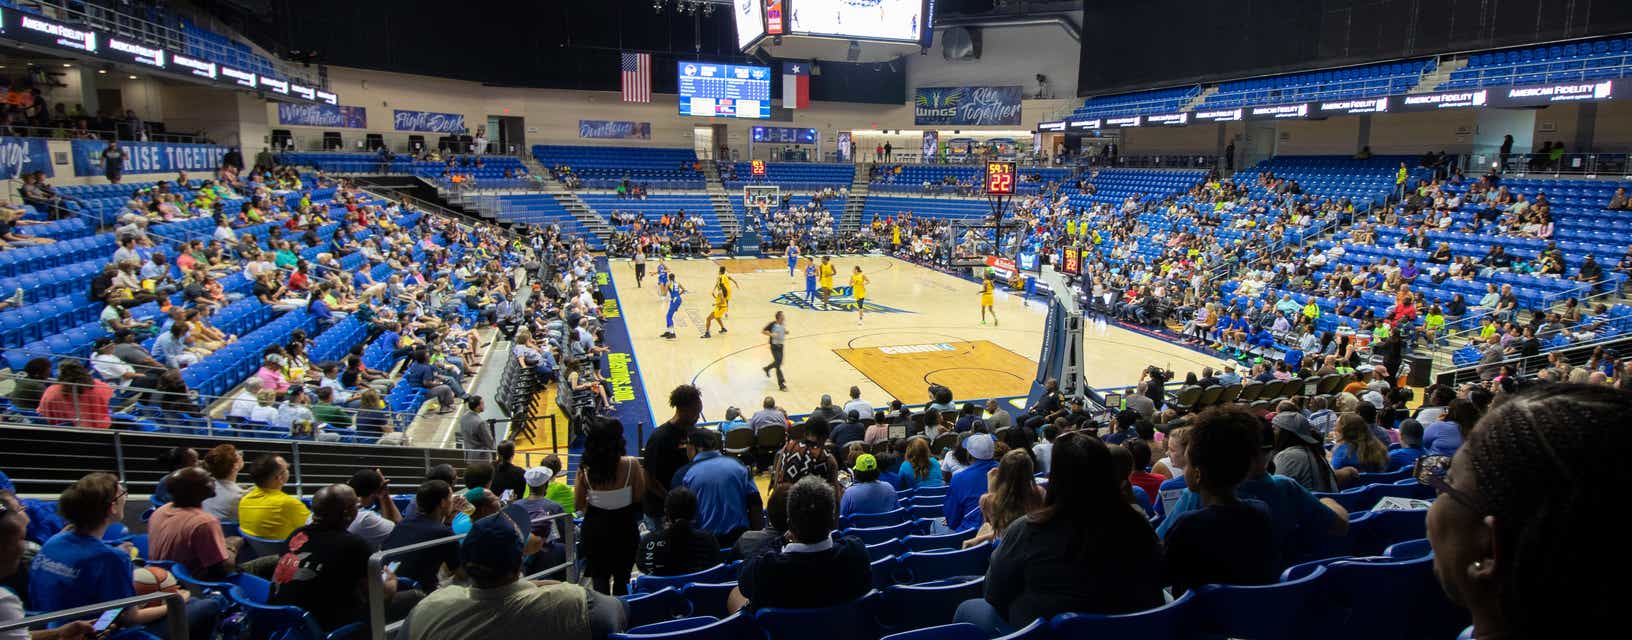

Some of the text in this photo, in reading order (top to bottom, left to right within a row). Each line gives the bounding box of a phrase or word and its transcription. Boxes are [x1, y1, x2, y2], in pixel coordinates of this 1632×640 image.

[1508, 84, 1595, 97] AMERICAN FIDELITY
[1404, 93, 1473, 104] AMERICAN FIDELITY
[1320, 100, 1376, 110] AMERICAN FIDELITY
[916, 107, 957, 117] WINGS
[961, 101, 1021, 125] Together
[123, 145, 229, 171] RISE TOGETHE
[989, 164, 1009, 174] 59.7
[991, 174, 1011, 191] 22
